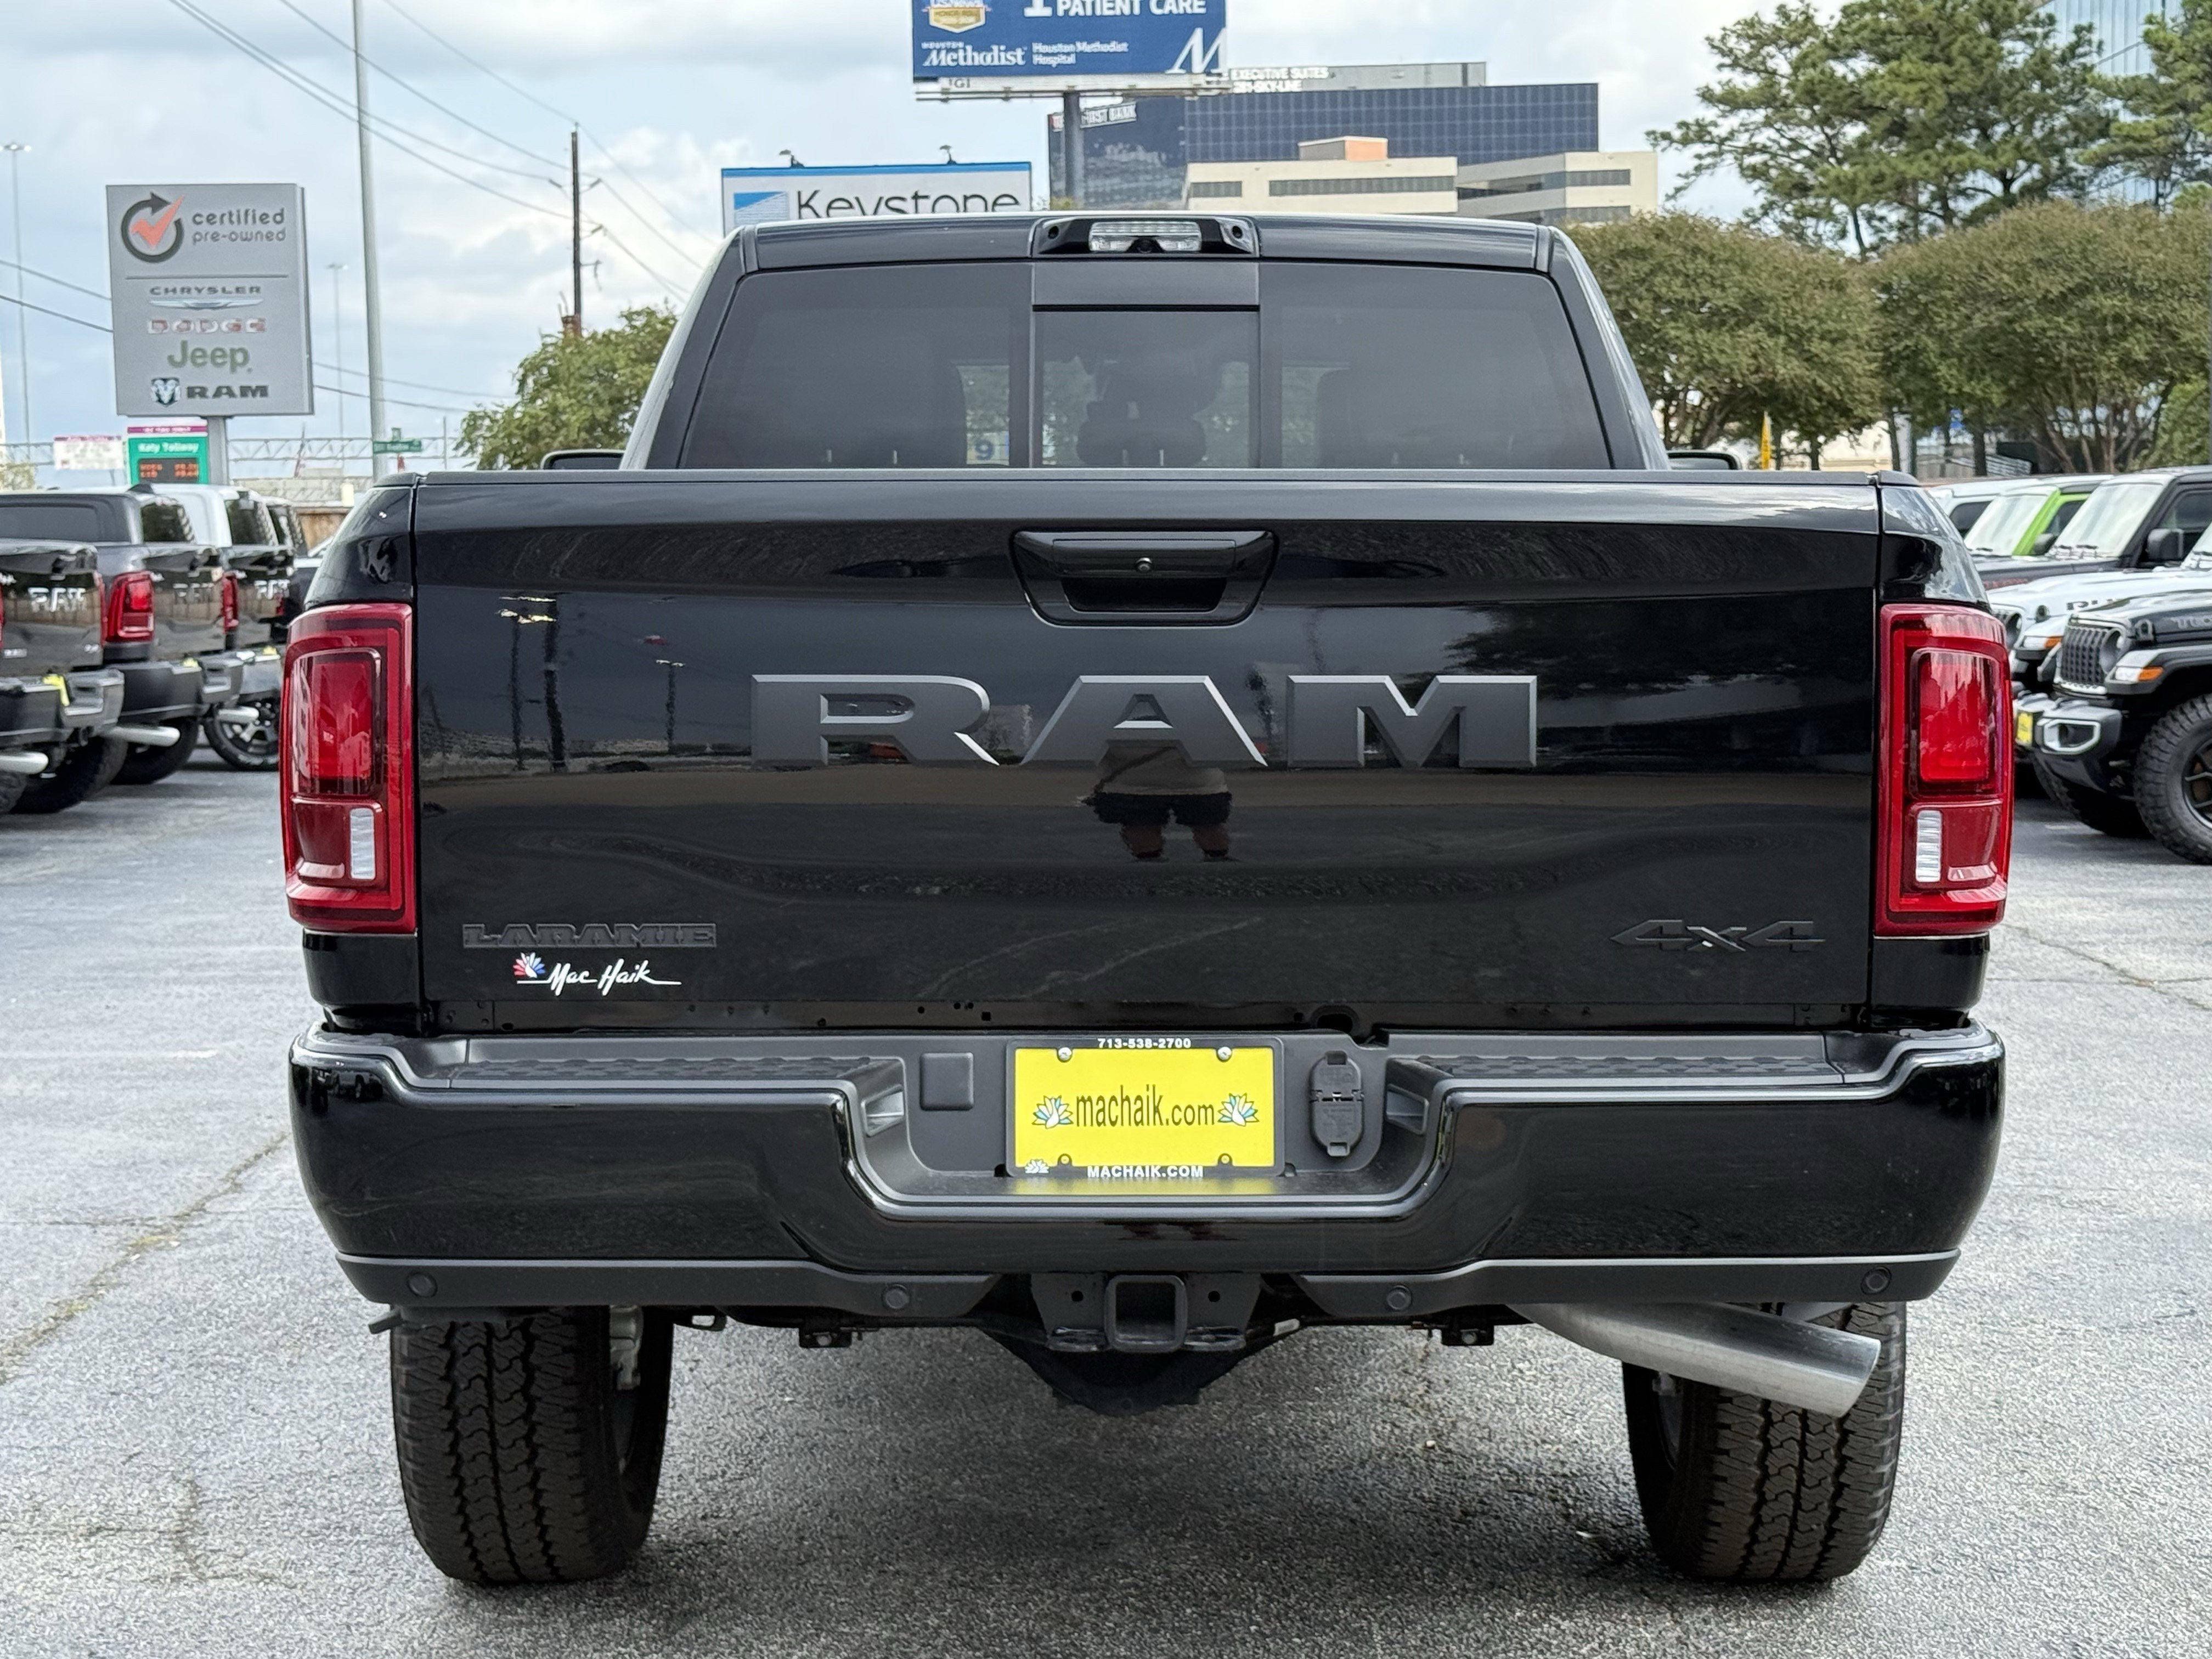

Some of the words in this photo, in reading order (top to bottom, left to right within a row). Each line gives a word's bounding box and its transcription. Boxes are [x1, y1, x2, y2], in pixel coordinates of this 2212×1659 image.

[1057, 0, 1141, 16] PATIENT
[1149, 0, 1207, 14] CARE
[922, 44, 1026, 66] Methodist
[192, 208, 285, 225] certified
[192, 228, 286, 245] pre-owned
[149, 286, 262, 295] CHRYSLER
[148, 318, 266, 334] DODGE
[167, 340, 250, 374] Jeep
[186, 385, 269, 399] RAM
[751, 674, 1538, 768] RAM
[462, 923, 717, 948] LARAMIE
[545, 962, 597, 996] Mac
[597, 958, 656, 996] Haik
[1097, 1037, 1192, 1049] 713-538-2700
[1075, 1084, 1215, 1127] machaik.com
[1087, 1165, 1204, 1178] MACHAIK.COM
